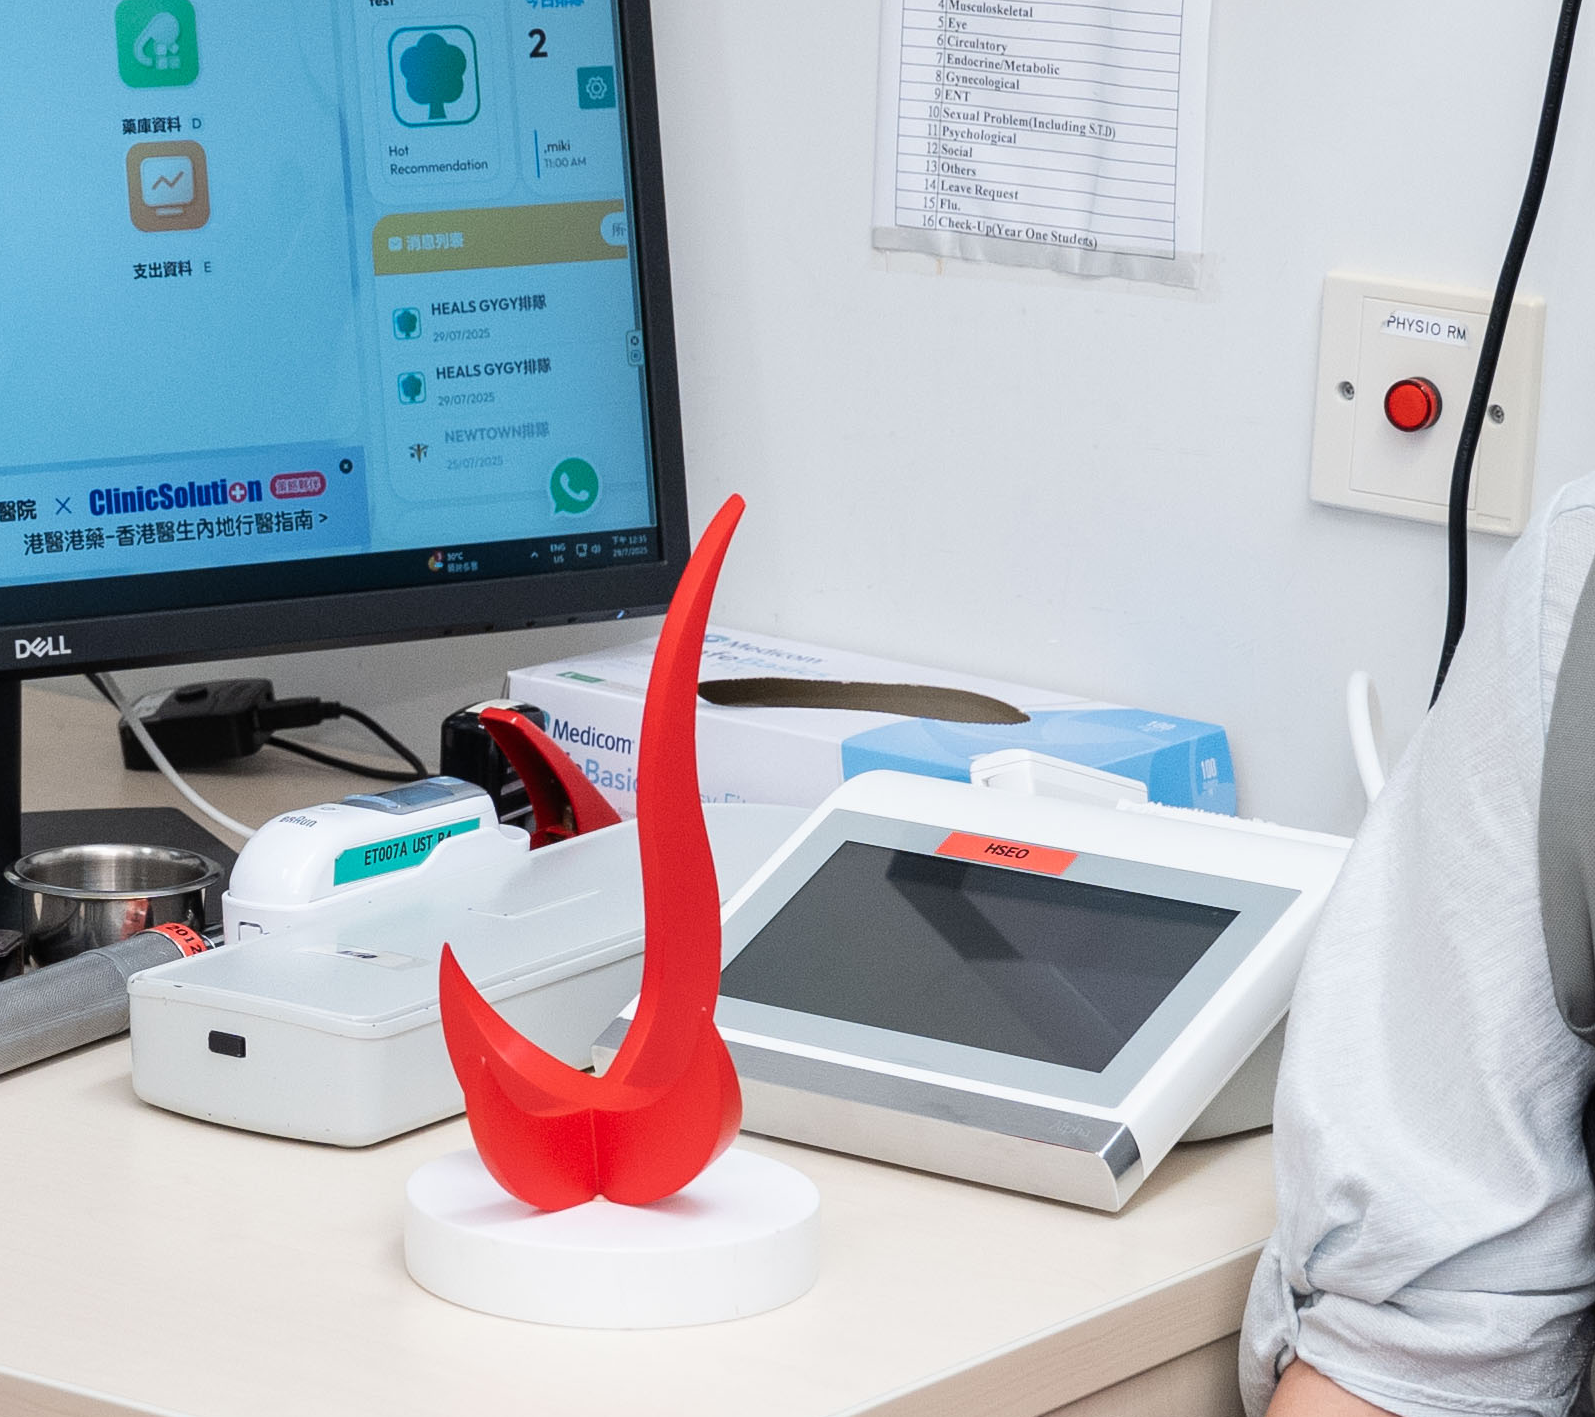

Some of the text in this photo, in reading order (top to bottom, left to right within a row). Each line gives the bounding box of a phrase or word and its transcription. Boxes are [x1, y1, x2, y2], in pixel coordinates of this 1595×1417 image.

[949, 0, 1033, 18] Musculoskeletal
[937, 16, 967, 32] 5 Eye
[528, 29, 548, 58] 2
[937, 34, 1008, 54] 6 Circulatory
[936, 53, 1060, 76] 7 Endocrine/Metabolic
[935, 71, 1020, 92] 8 Gynecological
[934, 89, 971, 102] 9 ENT
[192, 118, 202, 129] D
[928, 106, 939, 119] 10
[943, 107, 980, 122] Sexual
[983, 111, 1086, 136] Problem(Including
[927, 124, 1017, 145] 11 Psychological
[389, 144, 409, 158] Hot
[926, 143, 973, 158] 12 Social
[391, 158, 488, 175] Recommendation
[544, 156, 587, 169] 11:00 AM
[925, 160, 977, 177] 13 Others
[924, 179, 1019, 202] 14 Leave Request
[923, 197, 961, 212] 15 Flu.
[922, 215, 935, 228] 16
[938, 216, 1021, 240] Check-Up(Year
[1026, 228, 1048, 241] One
[133, 261, 212, 280] 支出資料 E
[431, 300, 476, 316] HEALS
[433, 328, 490, 343] 29/07/2025
[1386, 315, 1467, 341] PHYSIO RM
[436, 364, 481, 380] HEALS
[438, 392, 494, 407] 29/07/2025
[447, 455, 503, 470] 25/07/2025
[15, 635, 72, 660] DELL
[553, 718, 632, 755] Medicom
[365, 834, 432, 866] ET007A UST
[984, 843, 1030, 860] HSEO
